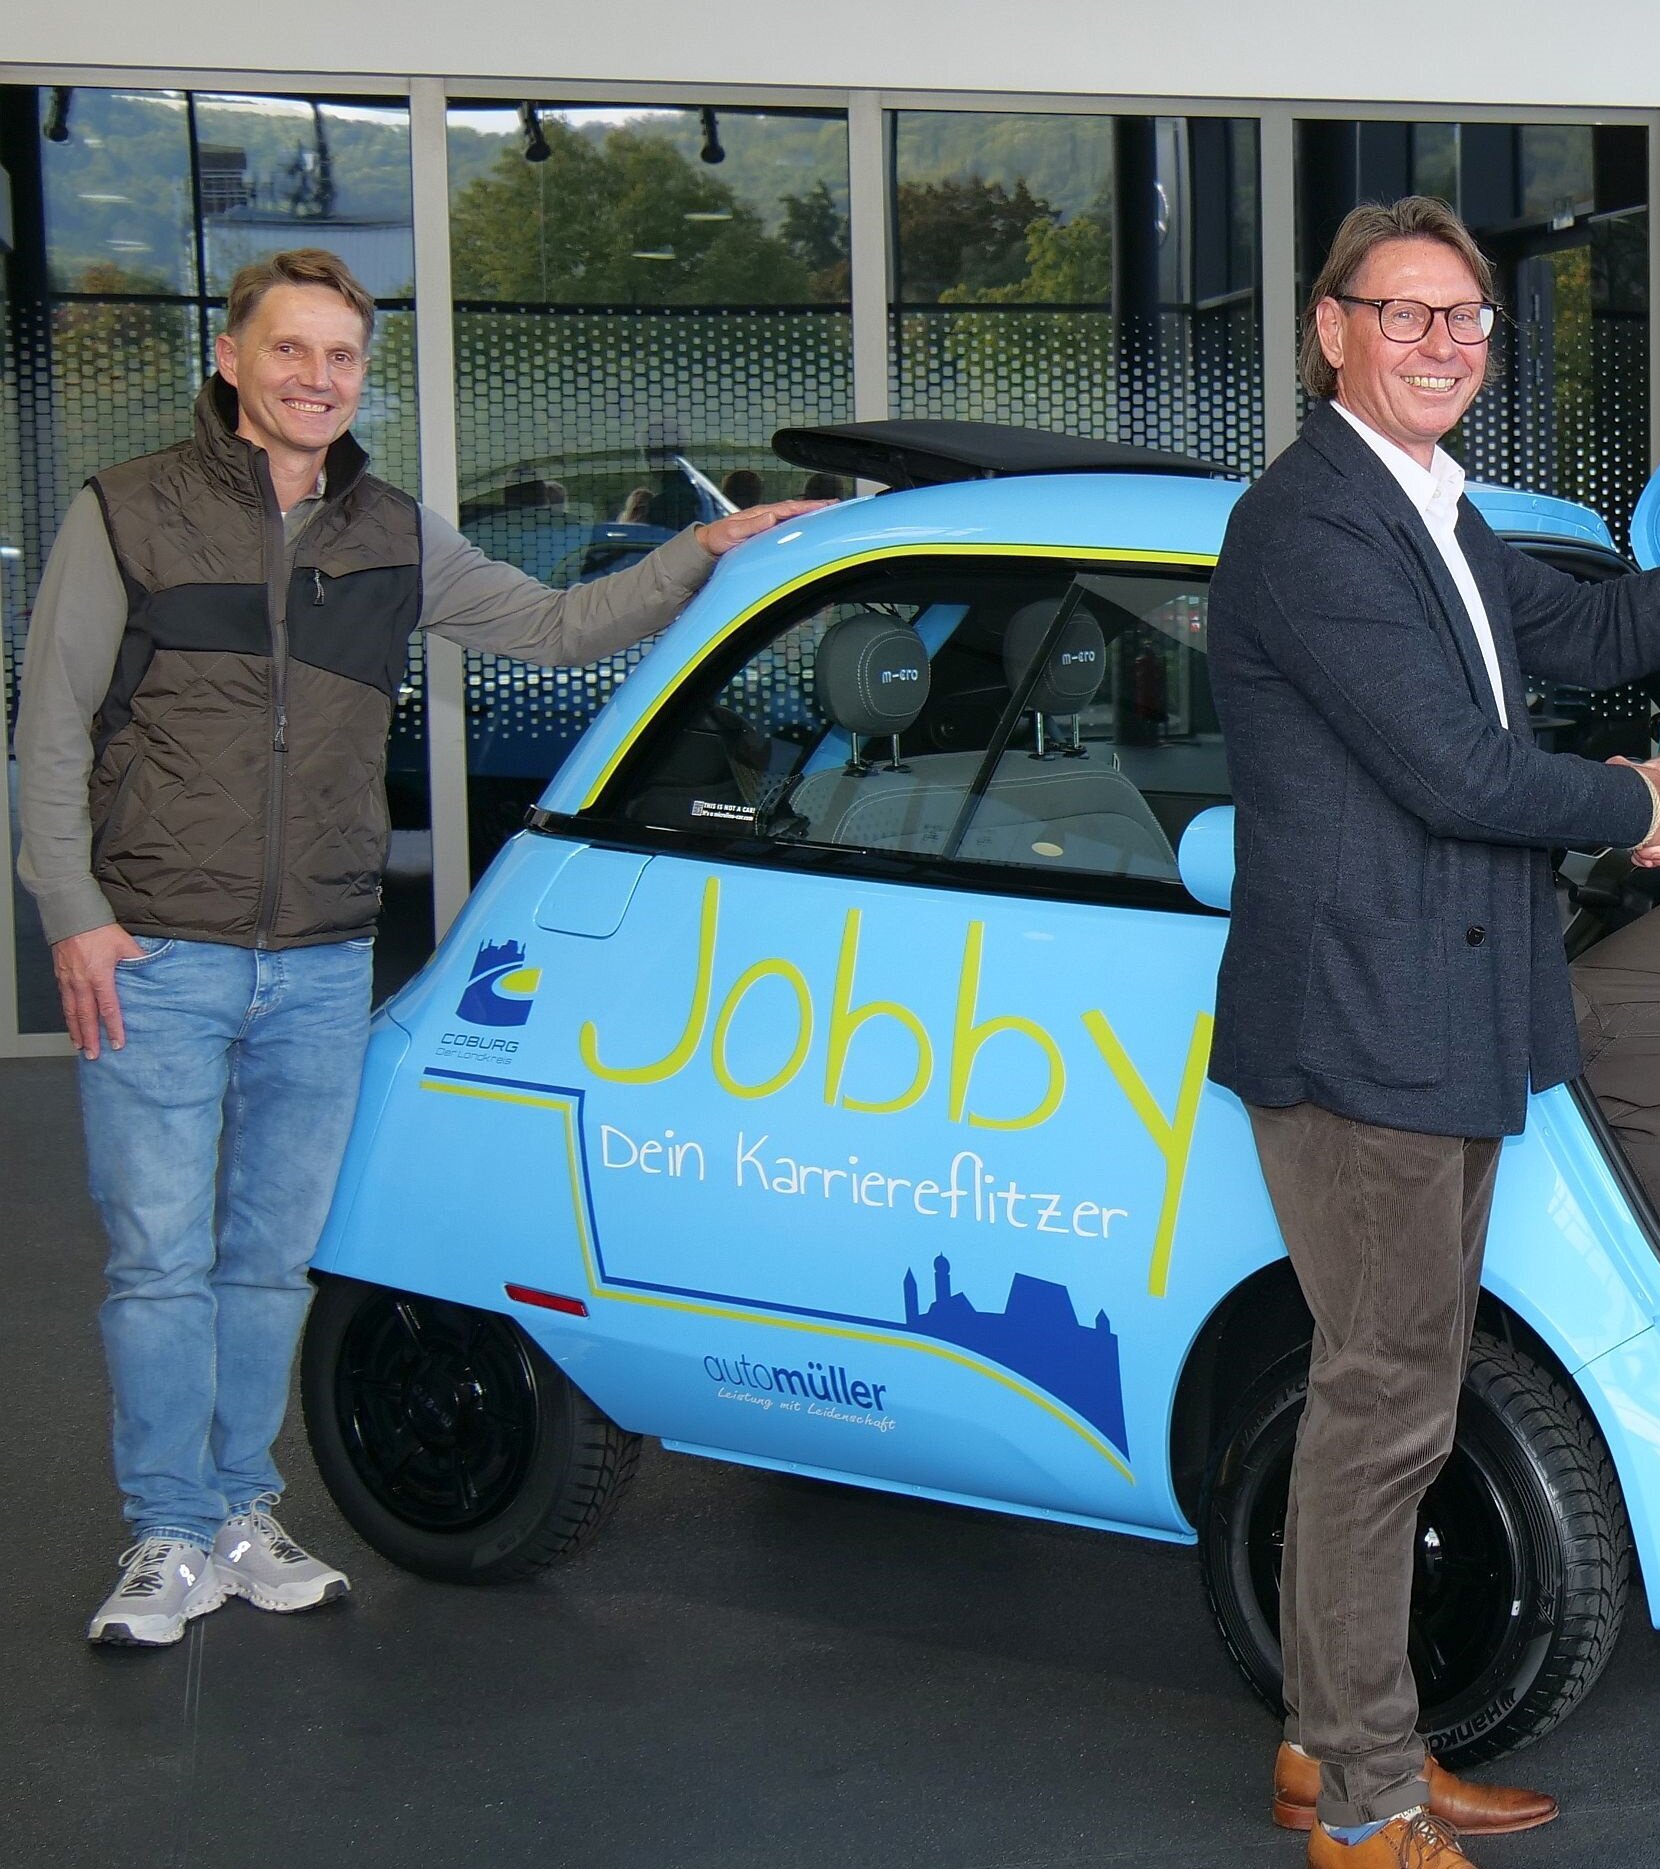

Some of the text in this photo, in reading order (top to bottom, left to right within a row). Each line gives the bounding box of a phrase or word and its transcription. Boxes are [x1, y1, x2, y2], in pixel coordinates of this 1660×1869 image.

[440, 1033, 520, 1053] COBURG
[580, 876, 1216, 1298] Jobby
[600, 1124, 1129, 1239] Dein Karriereflitzer
[703, 1354, 886, 1411] automüller
[717, 1387, 896, 1432] Leistung mit Leidenschaft
[1424, 1701, 1504, 1755] Hanko
